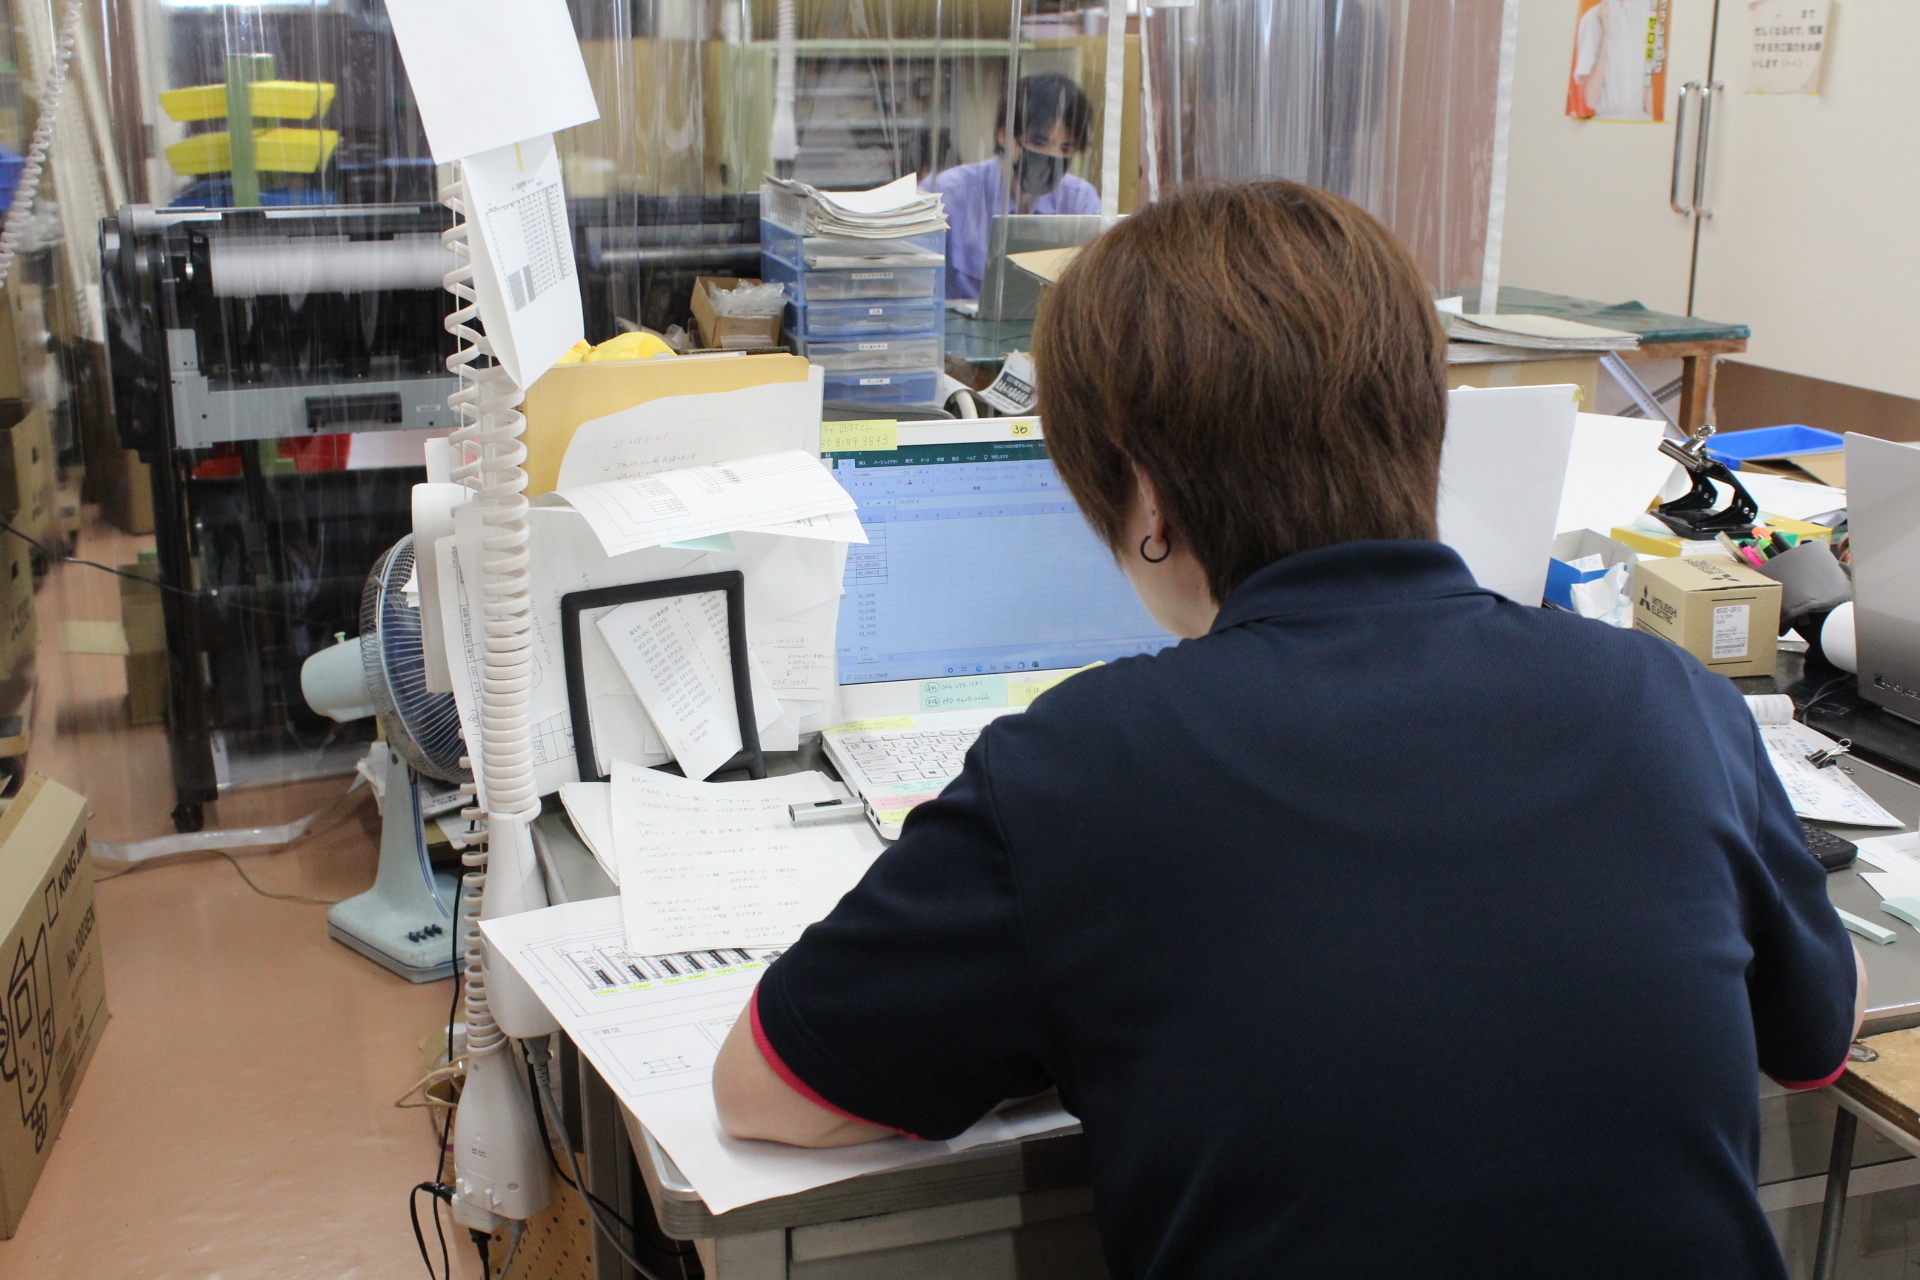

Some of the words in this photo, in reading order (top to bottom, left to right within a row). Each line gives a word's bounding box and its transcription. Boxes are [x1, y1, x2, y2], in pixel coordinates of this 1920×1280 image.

[1013, 425, 1028, 434] 30
[1651, 605, 1673, 625] ELECTRIC
[1652, 595, 1678, 618] MITSUBISHI
[58, 849, 77, 898] KING
